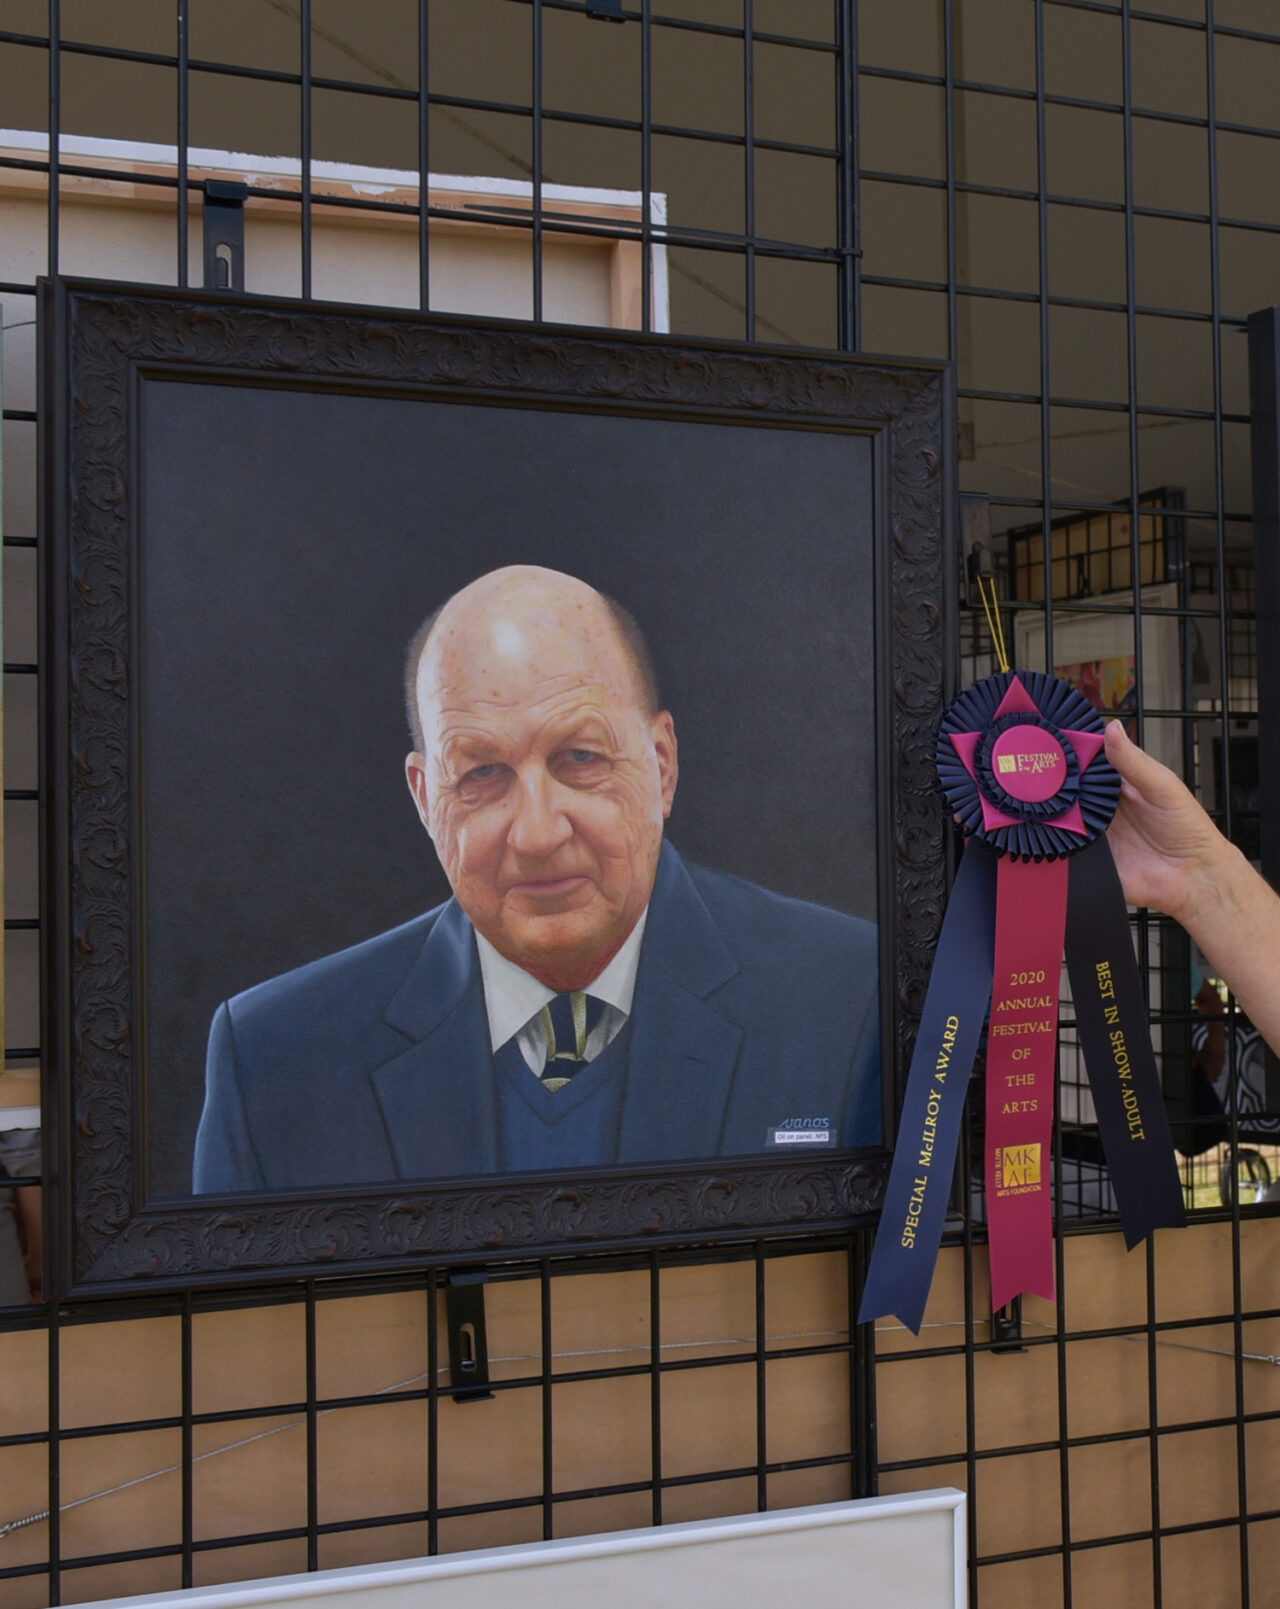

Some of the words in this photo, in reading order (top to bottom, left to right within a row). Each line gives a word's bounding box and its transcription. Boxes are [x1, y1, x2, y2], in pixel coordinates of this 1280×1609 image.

[1017, 752, 1059, 768] FESTIVAL
[1010, 970, 1045, 986] 2020
[1096, 961, 1115, 999] BEST
[996, 995, 1053, 1012] ANNUAL
[1104, 1004, 1120, 1025] IN
[993, 1021, 1053, 1037] FESTIVAL
[1012, 1048, 1031, 1060] OF
[1005, 1073, 1035, 1087] THE
[1002, 1100, 1038, 1114] ARTS
[902, 1175, 928, 1249] SPECIAL
[918, 1089, 942, 1167] McILROY
[934, 1015, 960, 1084] AWARD
